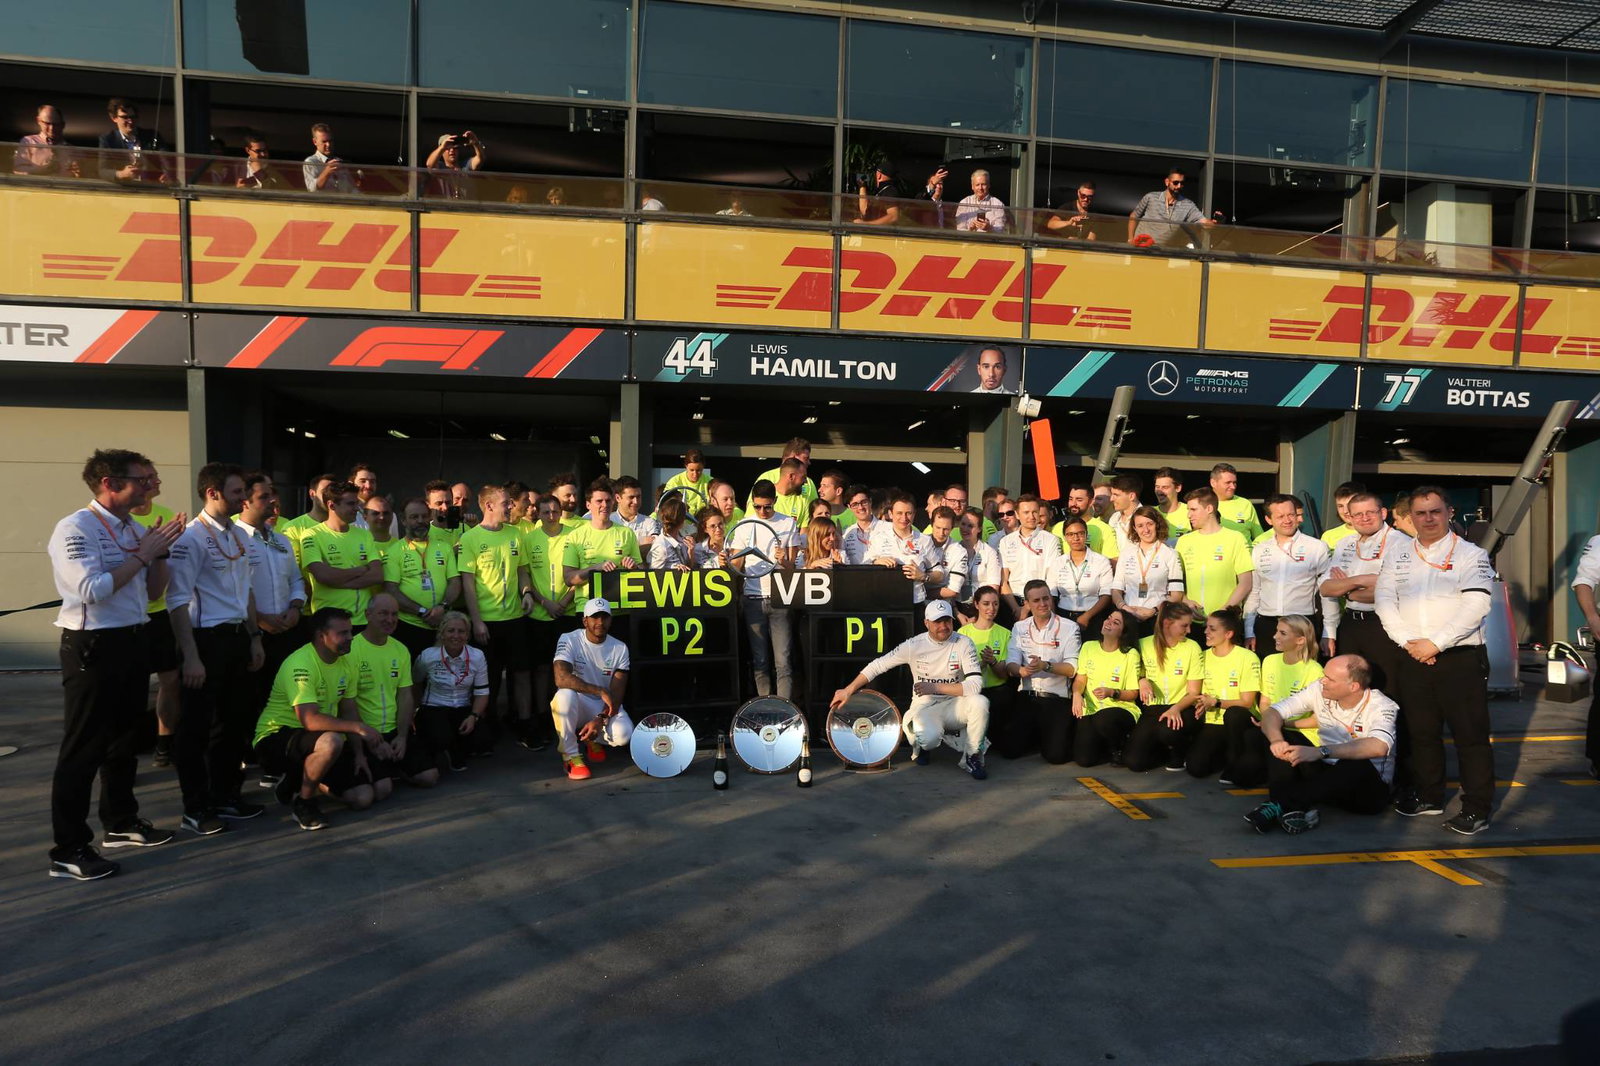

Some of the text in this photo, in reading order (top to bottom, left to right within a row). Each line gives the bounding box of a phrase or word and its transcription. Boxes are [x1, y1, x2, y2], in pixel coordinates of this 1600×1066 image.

[115, 211, 478, 296] DHL
[774, 246, 1081, 326] DHL
[1315, 285, 1563, 353] DHL
[0, 322, 70, 347] TER
[751, 344, 788, 354] LEWIS
[663, 337, 718, 376] 44
[750, 356, 897, 381] HAMILTON
[1186, 376, 1249, 387] PETRONAS
[1212, 369, 1249, 378] AMG
[1448, 378, 1491, 388] VALTTERI
[1194, 386, 1248, 394] MOTORSPORT
[1384, 374, 1421, 404] 77
[1447, 389, 1531, 408] BOTTAS
[593, 569, 733, 609] LEWIS
[772, 572, 832, 606] VB
[662, 617, 704, 656] P2
[846, 617, 885, 653] P1
